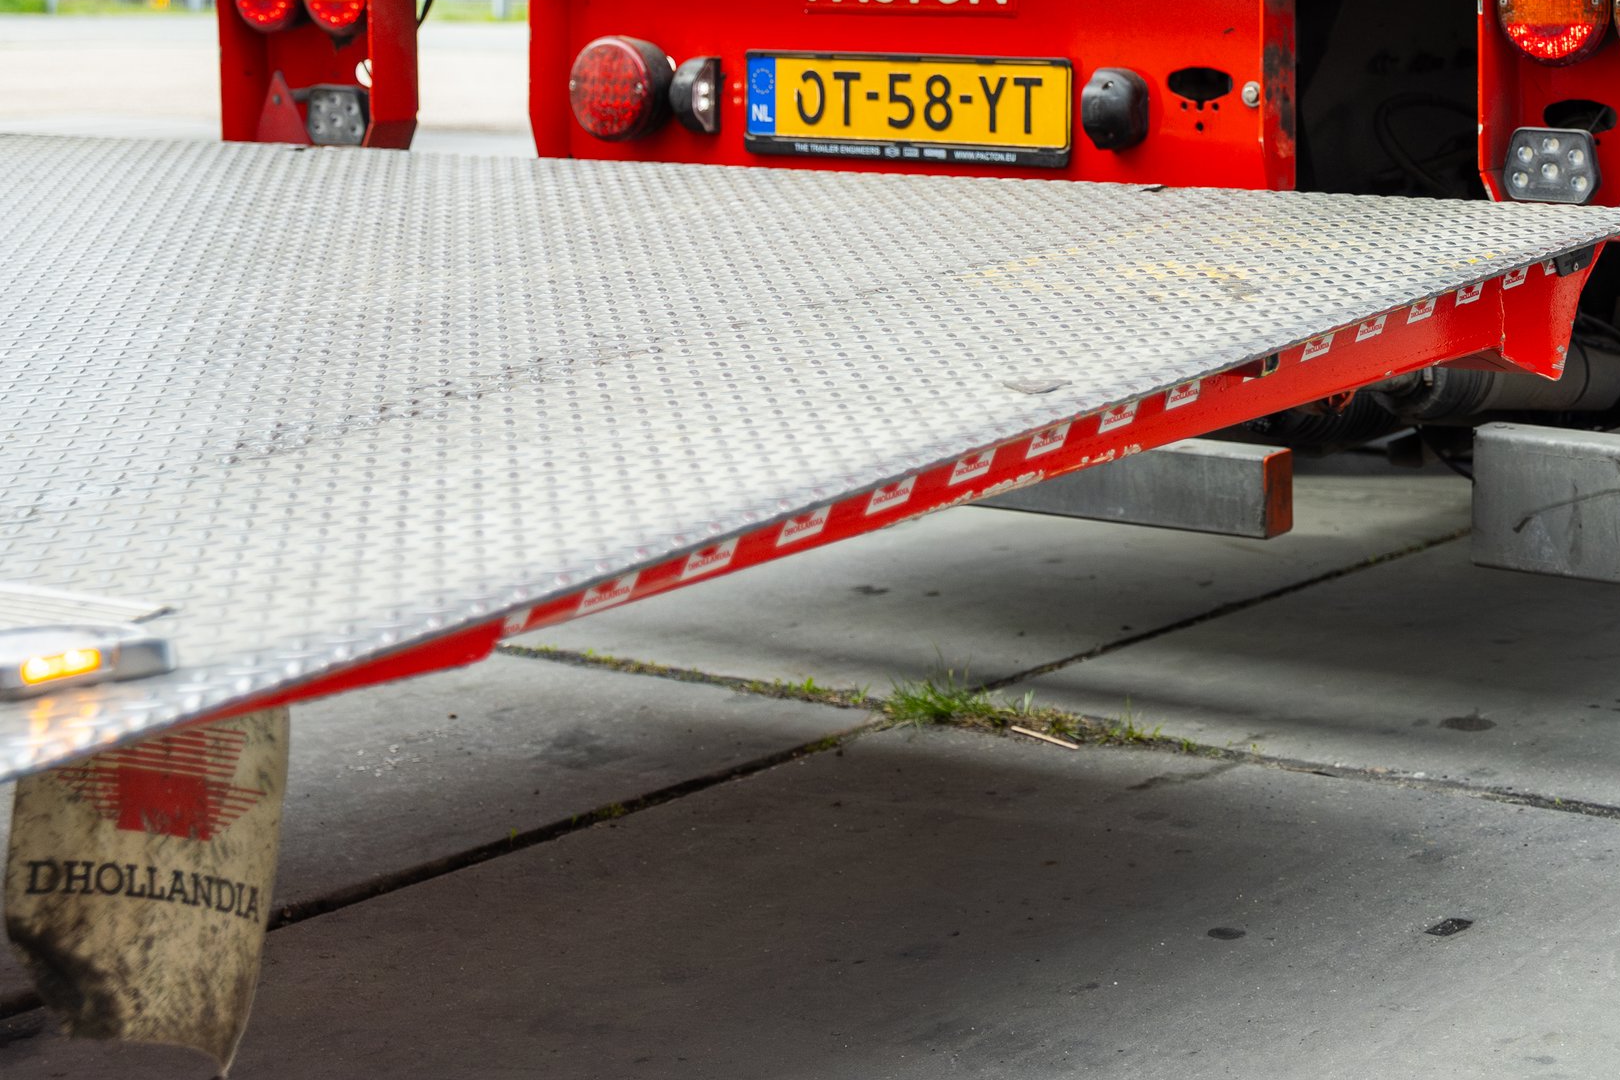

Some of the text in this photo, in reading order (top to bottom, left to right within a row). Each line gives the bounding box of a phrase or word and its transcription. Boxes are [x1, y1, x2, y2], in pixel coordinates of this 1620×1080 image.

[751, 102, 774, 124] NL
[796, 68, 1044, 135] OT-58-YT
[794, 142, 809, 153] THE
[810, 143, 839, 154] TRAILER
[840, 145, 881, 156] ENGINEERS
[25, 860, 260, 924] DHOLLANDIA
